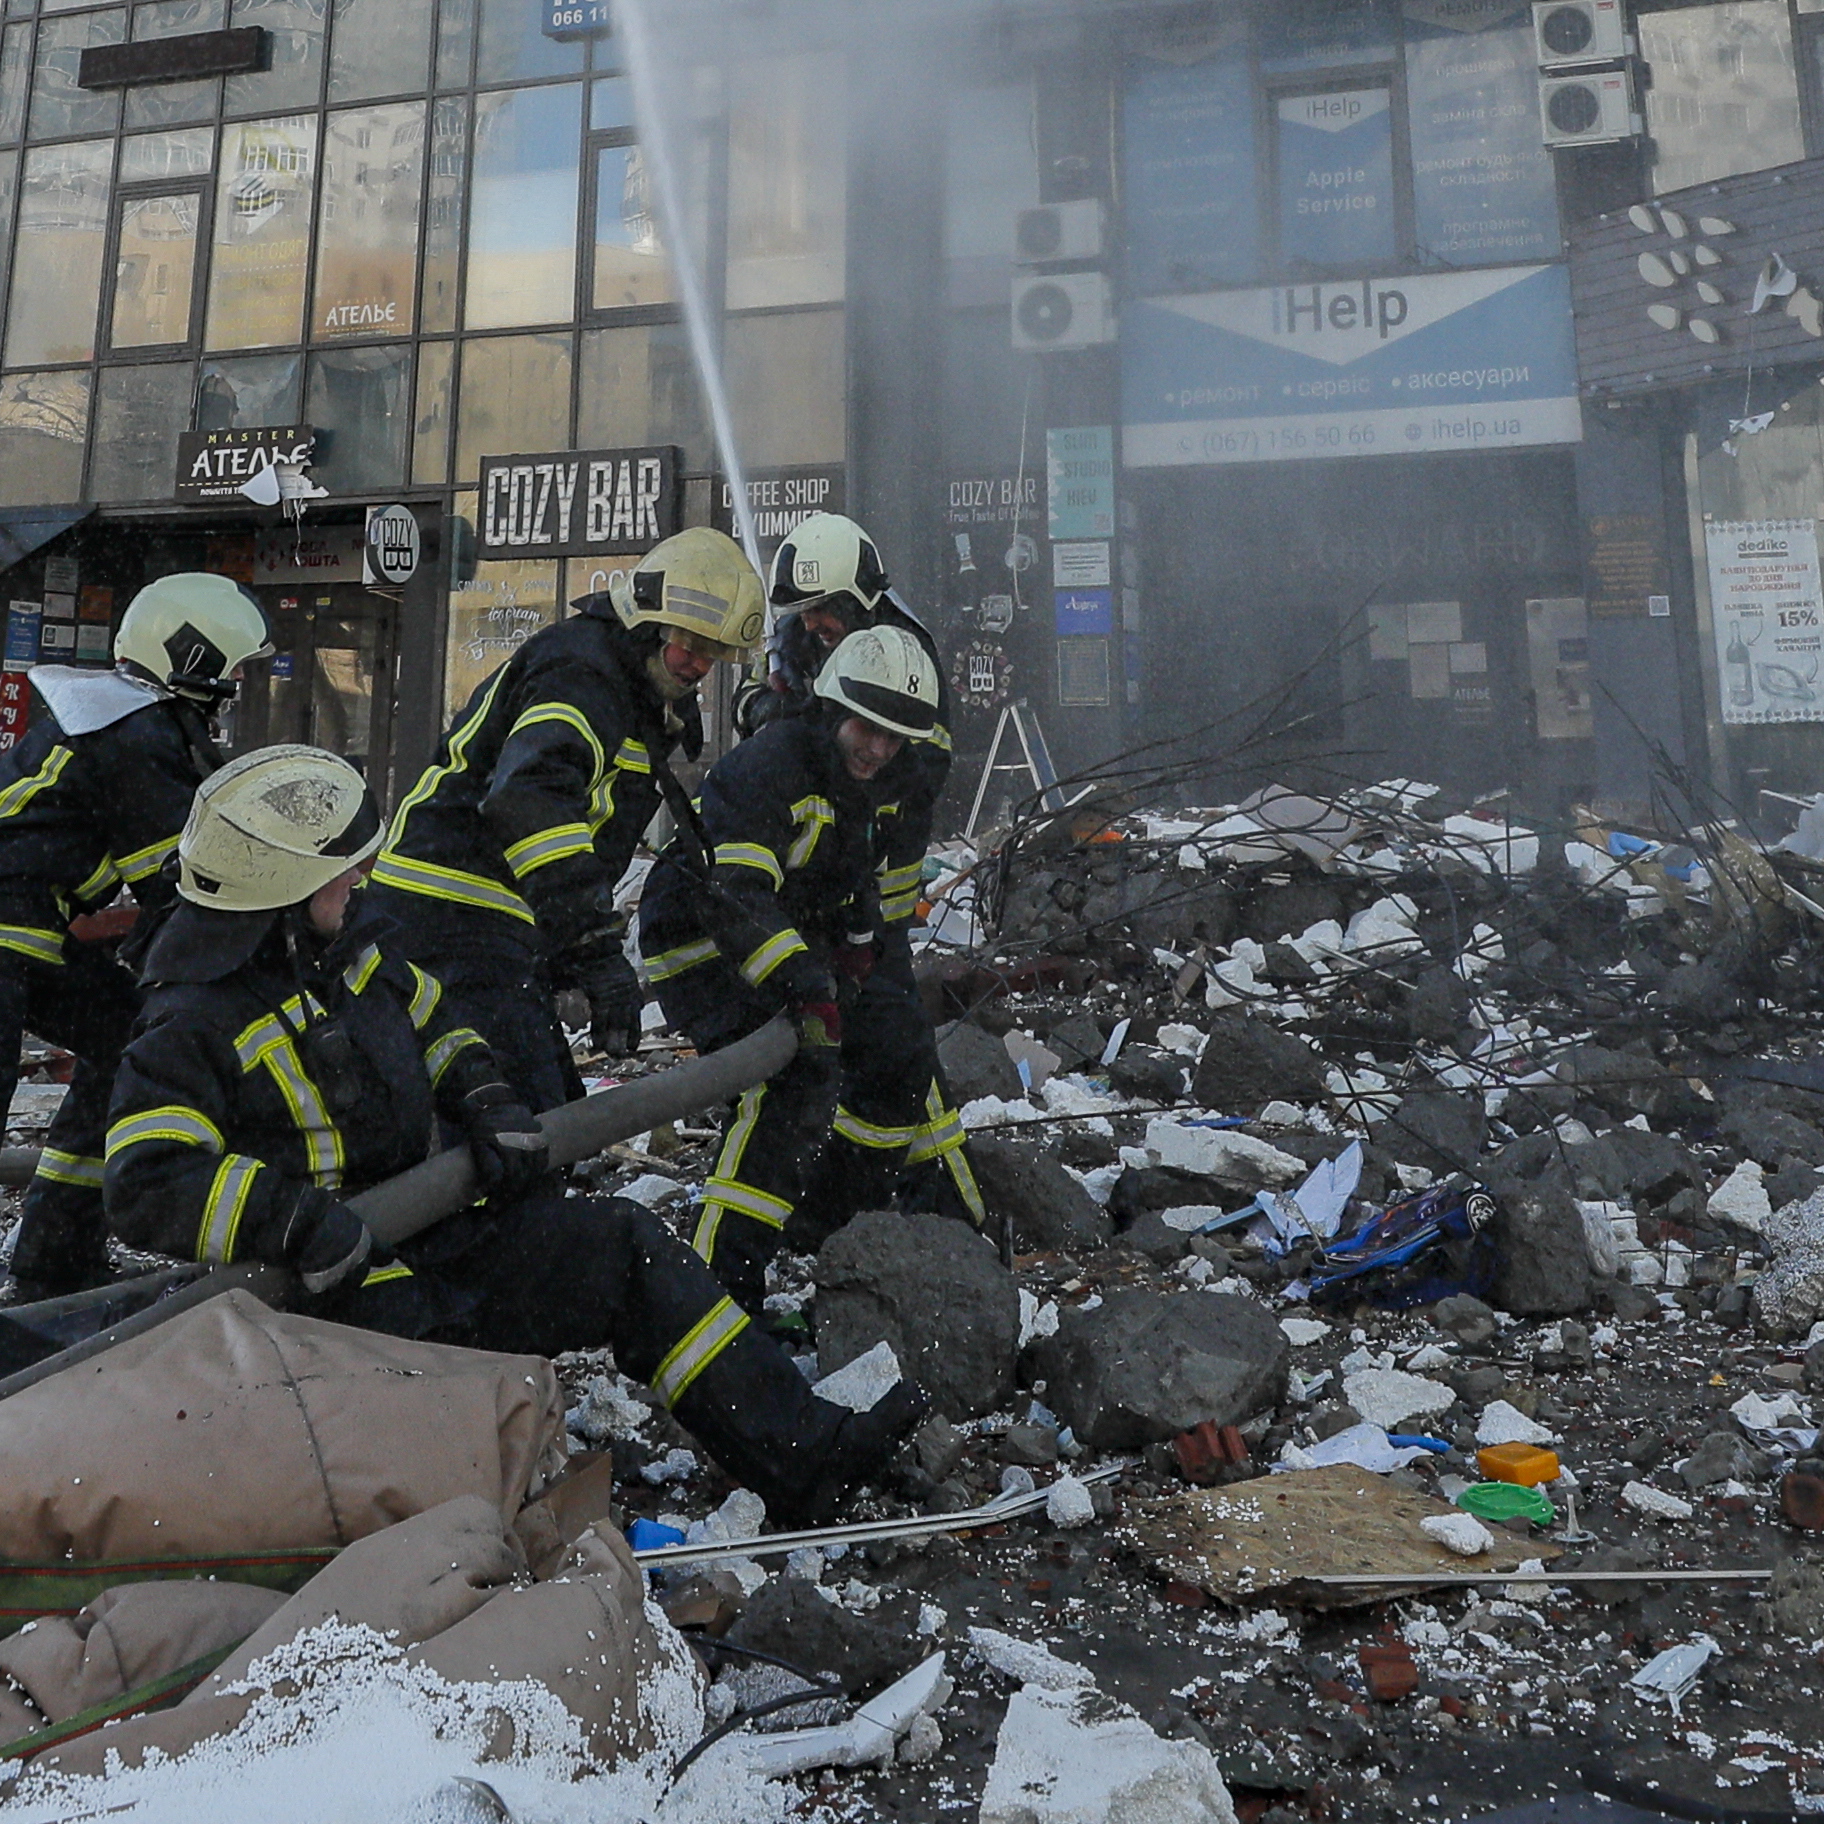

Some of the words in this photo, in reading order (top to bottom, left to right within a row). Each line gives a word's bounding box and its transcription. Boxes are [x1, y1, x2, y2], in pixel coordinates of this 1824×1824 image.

[552, 9, 584, 27] 066
[1306, 97, 1362, 121] iHelp
[1305, 166, 1366, 189] Apple
[1296, 193, 1377, 215] Service
[326, 302, 397, 327] АТЕЛЬЄ
[1275, 279, 1408, 339] iHelp
[1180, 383, 1263, 408] ремонт
[1297, 375, 1371, 401] сервіс
[1408, 364, 1530, 392] аксесуари
[208, 429, 295, 444] MASTER
[1202, 430, 1259, 458] (067)
[1315, 425, 1342, 448] 50
[1348, 422, 1377, 446] 66
[1431, 416, 1522, 440] ihelp.ua
[190, 443, 313, 478] АТЕЛЬЄ
[1064, 459, 1112, 478] STUDIO
[484, 462, 579, 546] COZY
[586, 457, 661, 542] BAR
[722, 480, 781, 508] CFFEE
[785, 478, 830, 506] SHOP
[949, 480, 995, 507] COZY
[1001, 478, 1036, 505] BAR
[948, 509, 970, 523] True
[972, 508, 996, 522] Taste
[998, 507, 1009, 521] Of
[384, 518, 413, 546] COZY
[1737, 538, 1789, 552] dediko
[288, 554, 341, 568] ПОШТА
[1777, 609, 1819, 627] 15%
[969, 655, 995, 674] COZY
[907, 675, 920, 695] 8
